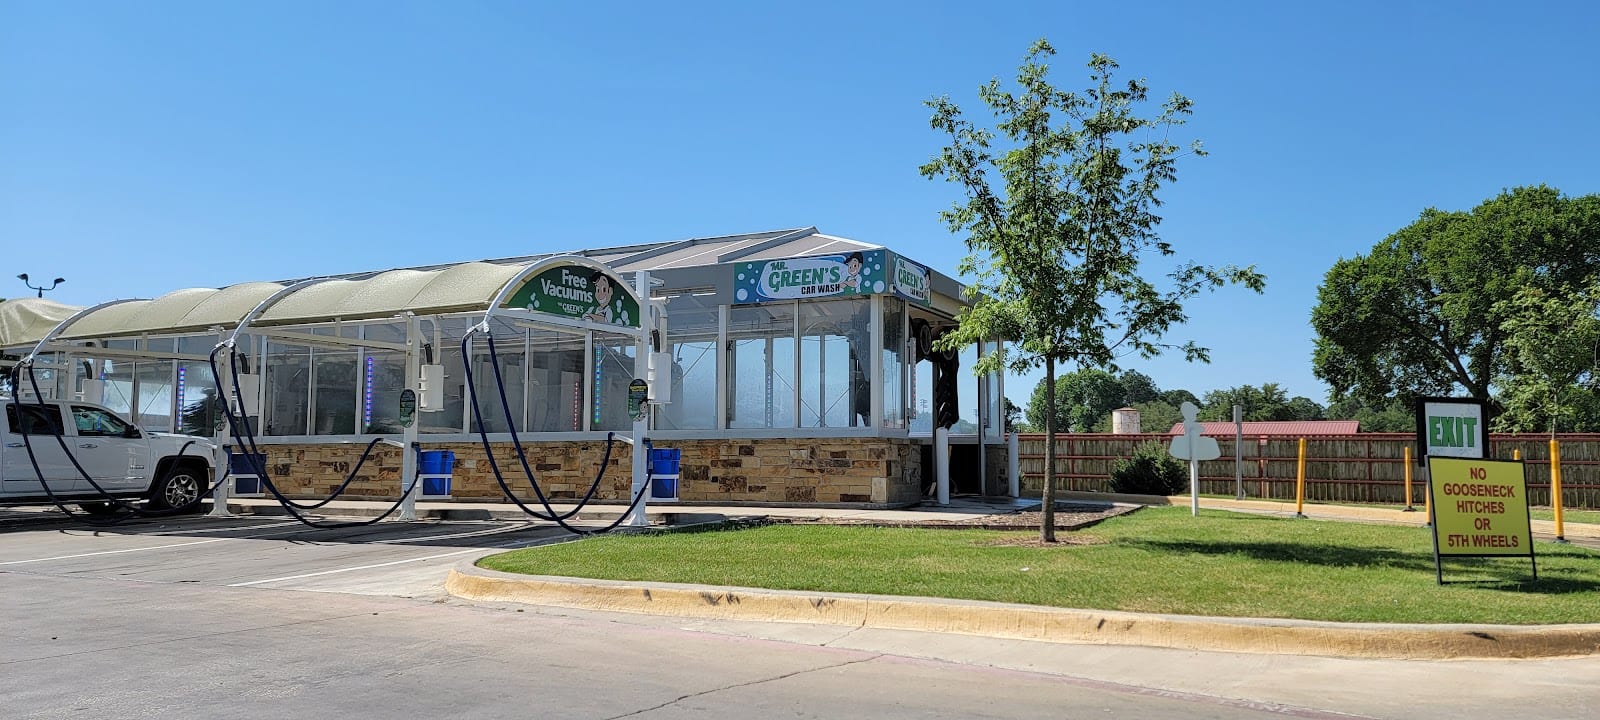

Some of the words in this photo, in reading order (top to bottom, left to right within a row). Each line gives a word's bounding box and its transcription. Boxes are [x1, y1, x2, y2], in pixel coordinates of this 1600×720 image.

[771, 261, 788, 271] MR.
[561, 269, 588, 289] Free
[768, 266, 841, 292] GREEN'S
[898, 268, 924, 291] GREEN'S
[541, 278, 593, 303] Vacuums
[801, 286, 816, 295] CAR
[818, 284, 840, 293] WASH
[562, 302, 584, 313] GREEN'S
[1429, 416, 1477, 448] EXIT
[1470, 467, 1487, 480] NO
[1443, 483, 1515, 498] GOOSENECK
[1456, 500, 1505, 514] HITCHES
[1474, 518, 1491, 530] OR
[1448, 534, 1469, 547] 5TH
[1473, 534, 1519, 548] WHEELS
